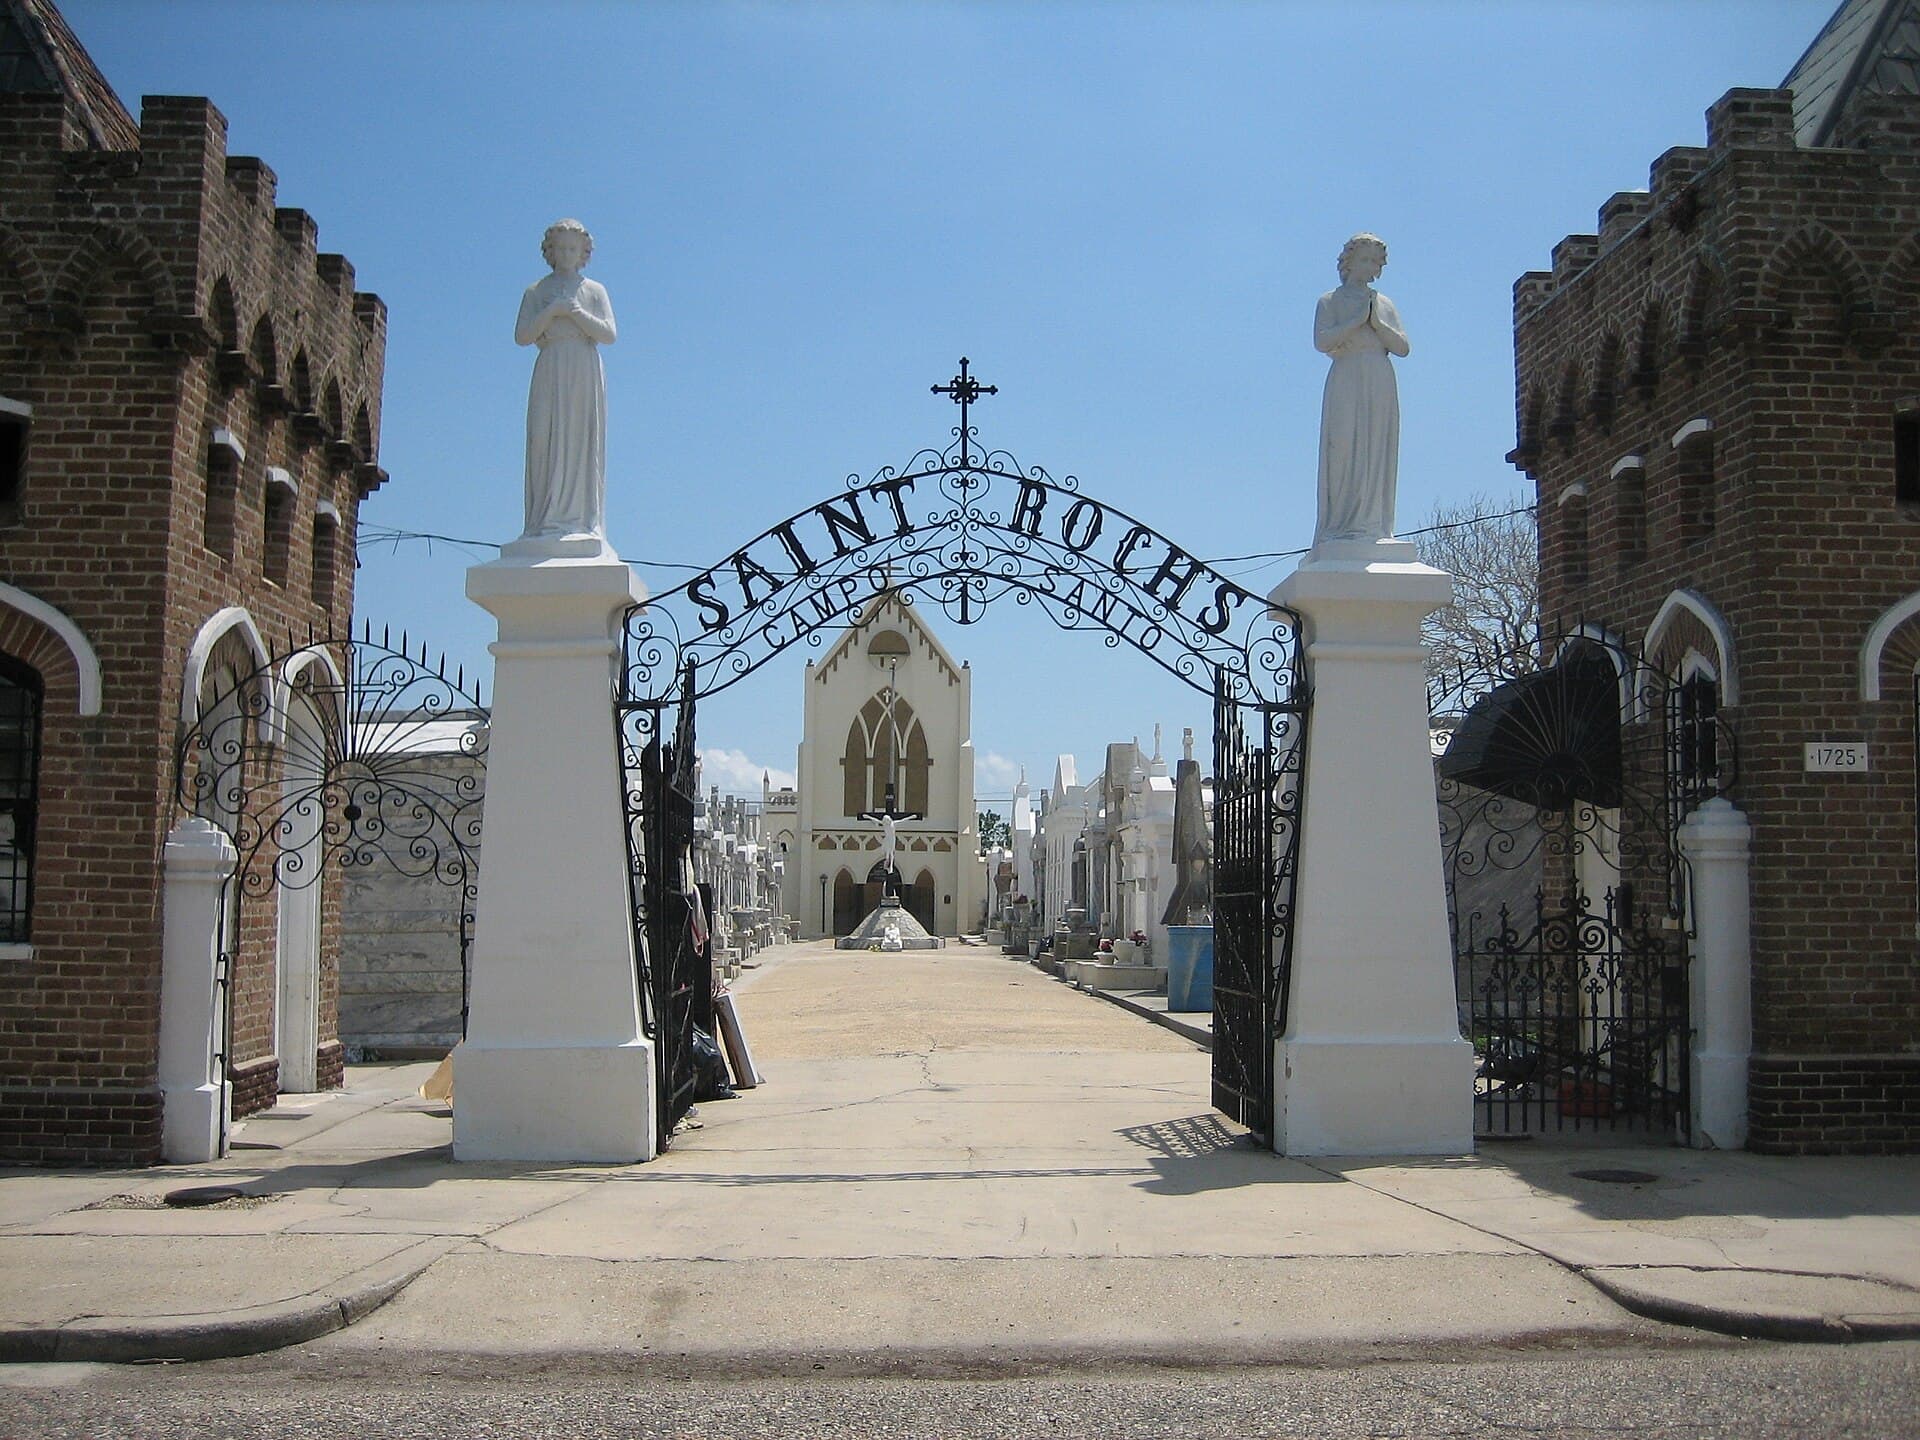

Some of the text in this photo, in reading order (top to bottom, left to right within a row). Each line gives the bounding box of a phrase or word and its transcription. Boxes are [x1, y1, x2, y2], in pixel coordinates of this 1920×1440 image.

[687, 477, 1249, 634] SAINT ROCH'S
[762, 566, 1163, 651] CAMPO SANTO
[1817, 749, 1857, 766] 1725
